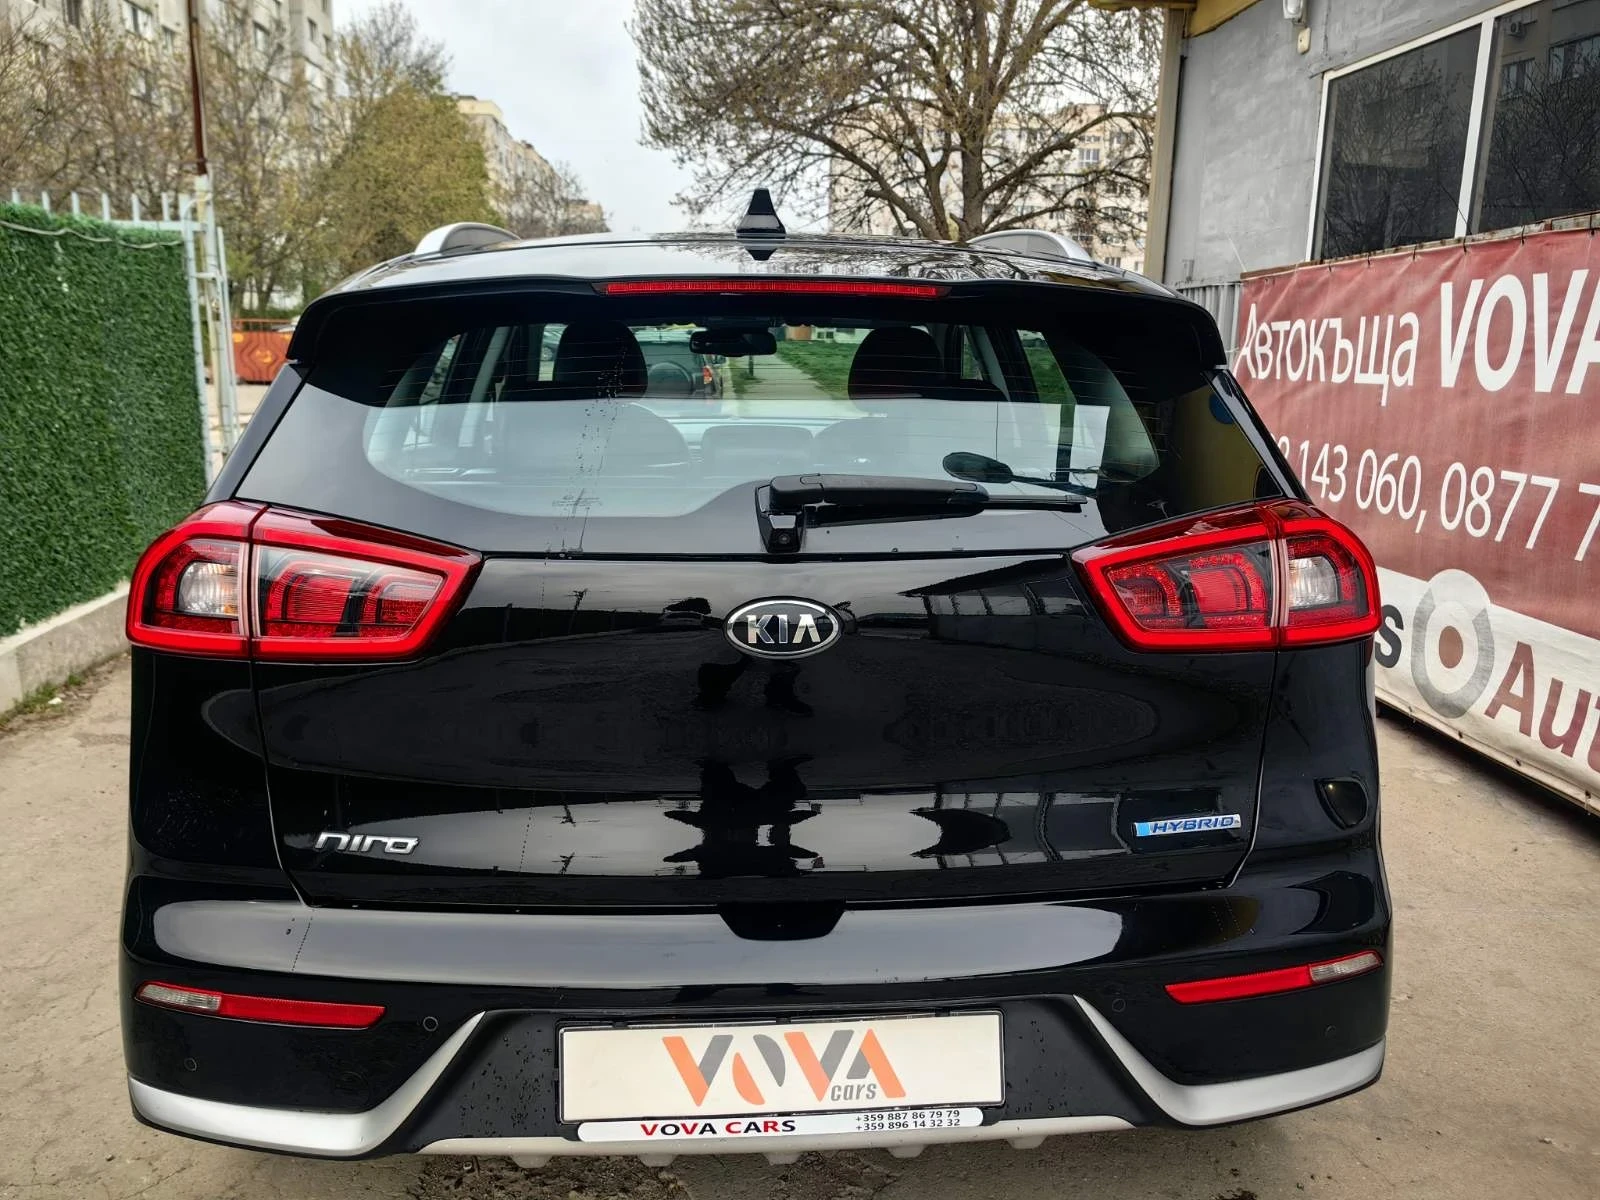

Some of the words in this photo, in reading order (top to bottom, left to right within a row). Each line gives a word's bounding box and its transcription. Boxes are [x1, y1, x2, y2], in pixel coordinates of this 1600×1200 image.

[1233, 303, 1420, 407] Автокъща
[1300, 440, 1348, 502] 143
[1355, 449, 1427, 534] 060,
[1440, 462, 1560, 549] 0877
[746, 613, 821, 644] KIA
[1152, 816, 1235, 833] HYBRID
[662, 1028, 907, 1107] VOVA
[830, 1083, 878, 1102] cars
[856, 1113, 883, 1122] +359
[887, 1112, 908, 1121] 887
[911, 1111, 926, 1119] 86
[947, 1110, 960, 1118] 79
[856, 1122, 884, 1131] +359
[887, 1120, 909, 1130] 896
[913, 1120, 926, 1128] 14
[930, 1119, 943, 1128] 32
[947, 1119, 960, 1127] 32
[640, 1122, 717, 1137] VOVA
[725, 1120, 797, 1135] CARS
